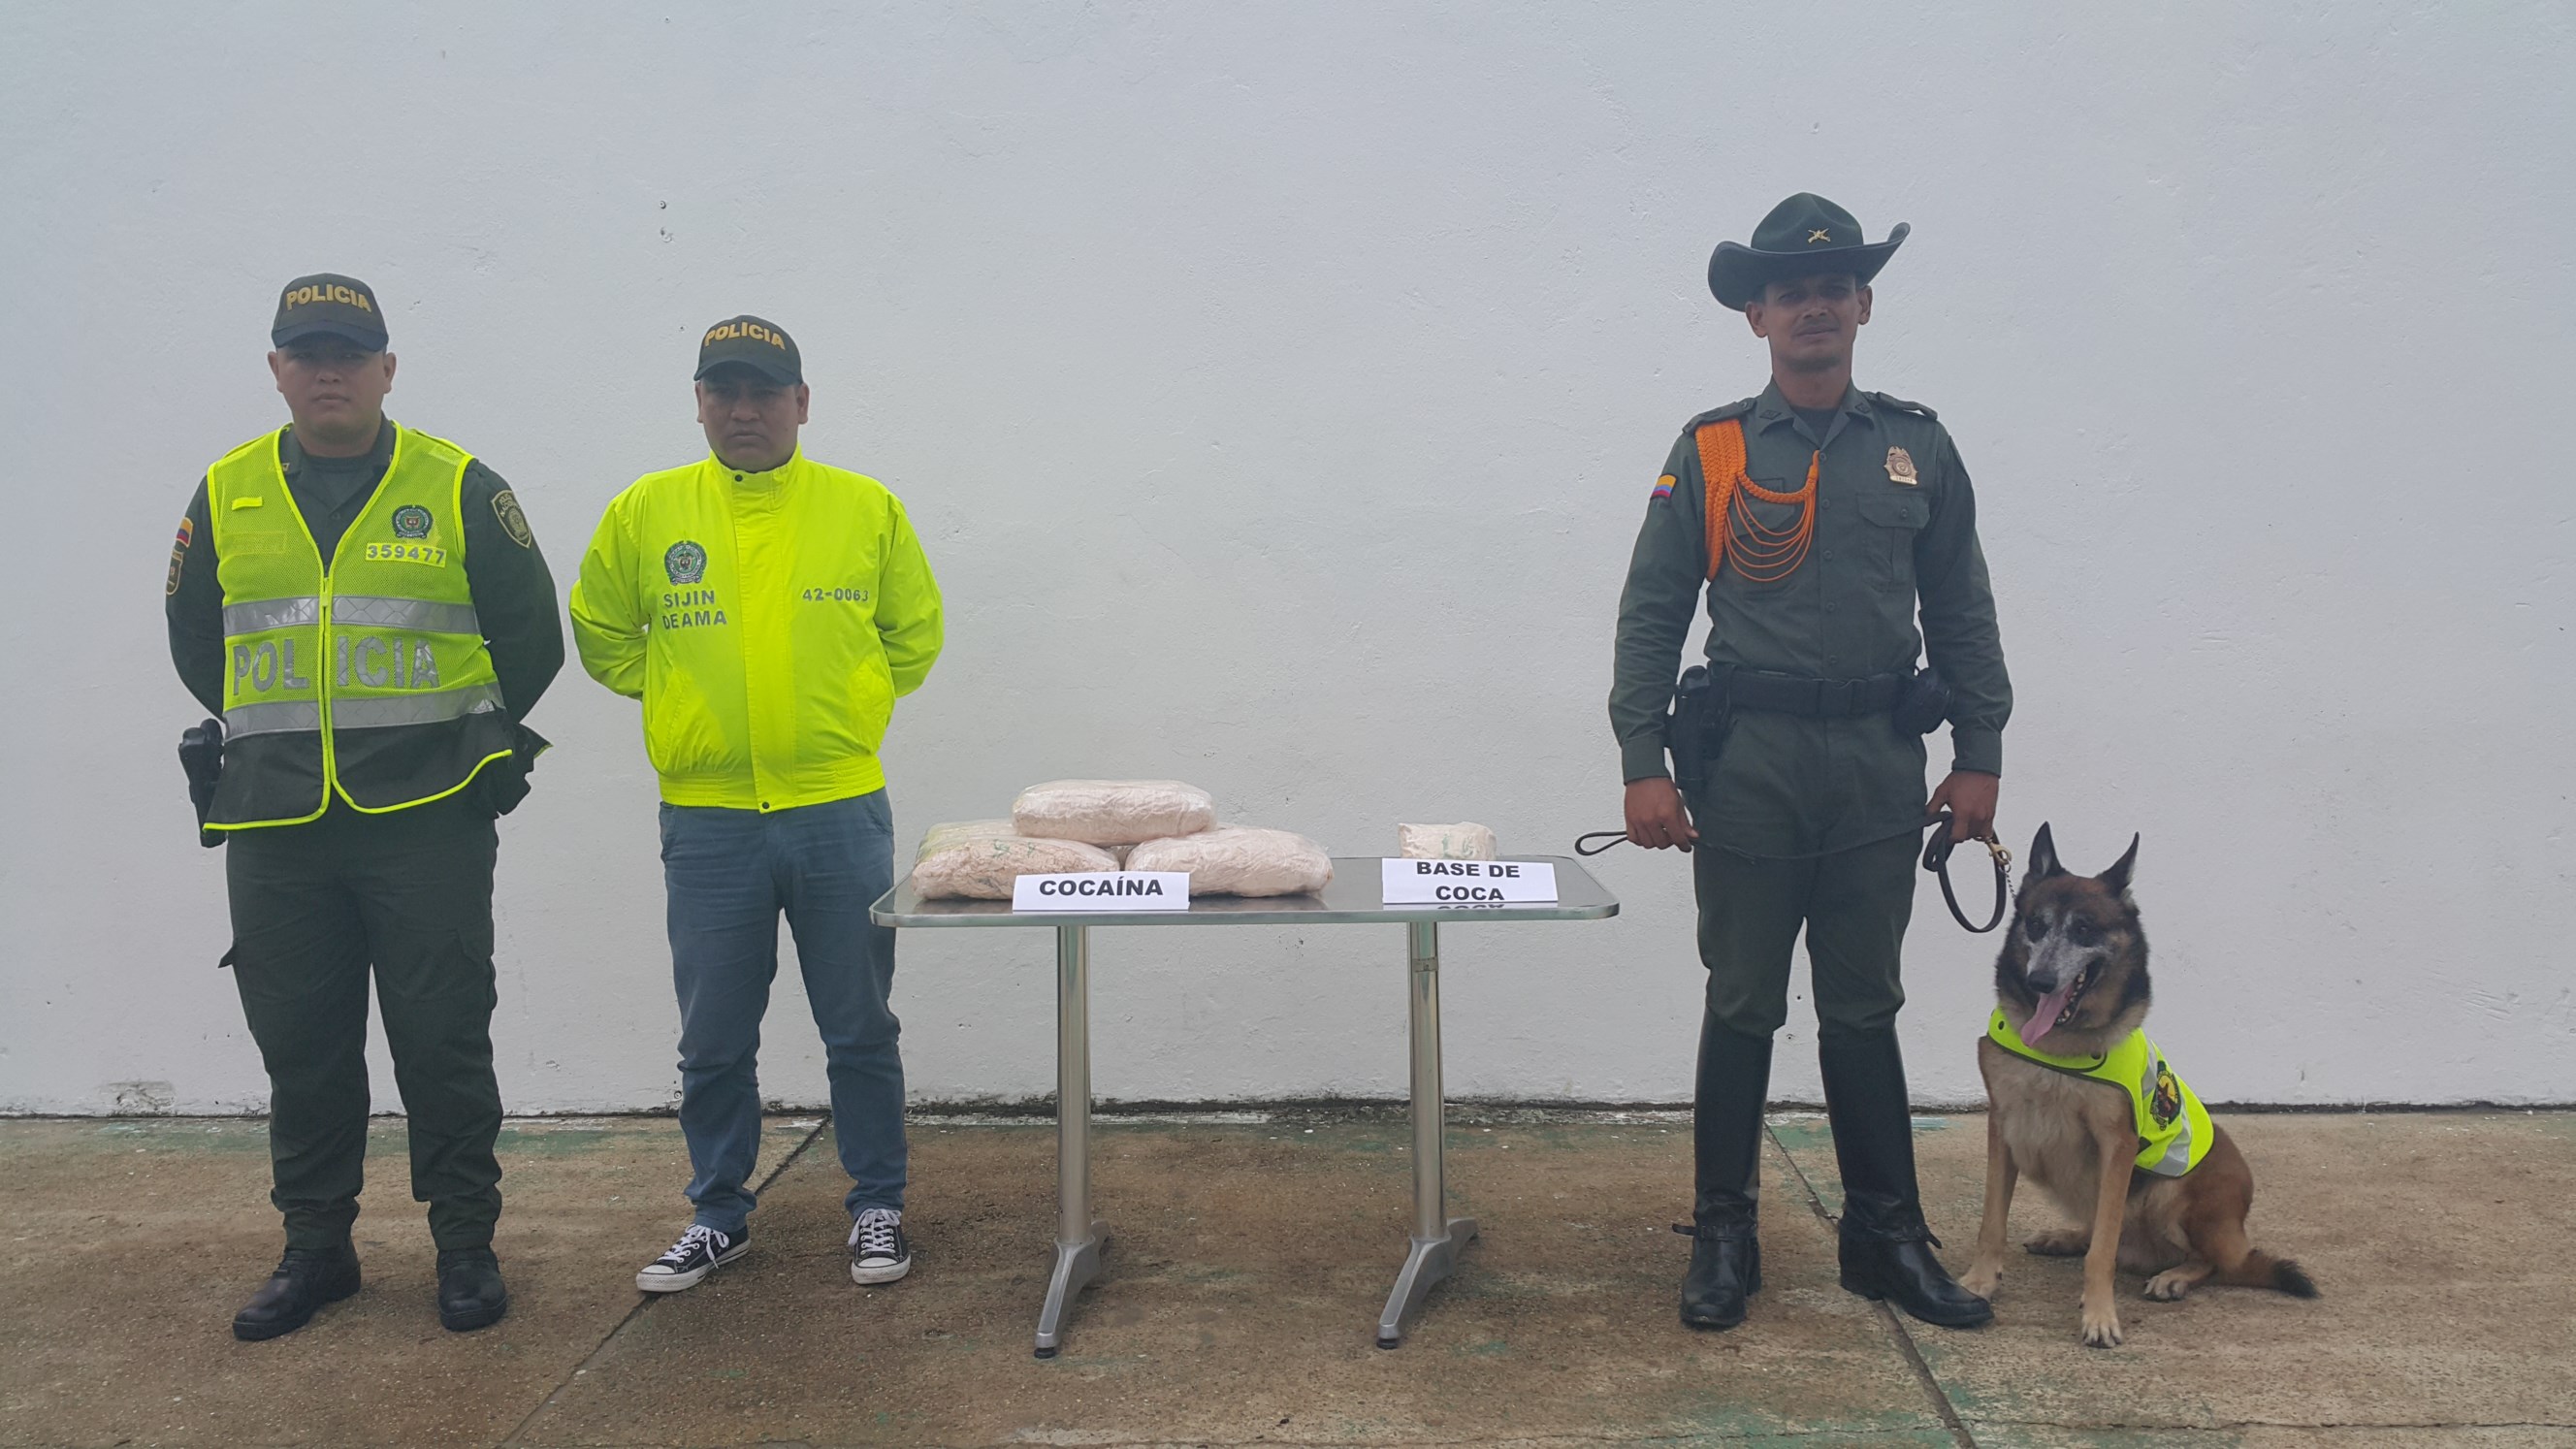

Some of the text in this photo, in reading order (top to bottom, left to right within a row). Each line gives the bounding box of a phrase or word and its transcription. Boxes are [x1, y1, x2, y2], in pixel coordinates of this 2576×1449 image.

[286, 283, 371, 312] POLICIA
[704, 321, 786, 350] POLICIA
[367, 544, 445, 564] 359477
[662, 590, 716, 608] SIJIN
[802, 588, 869, 602] 42-0063
[662, 610, 727, 629] DEAMA
[1416, 861, 1521, 878] BASE DE
[1039, 876, 1164, 896] COCAÍNA
[1435, 886, 1505, 901] COCA
